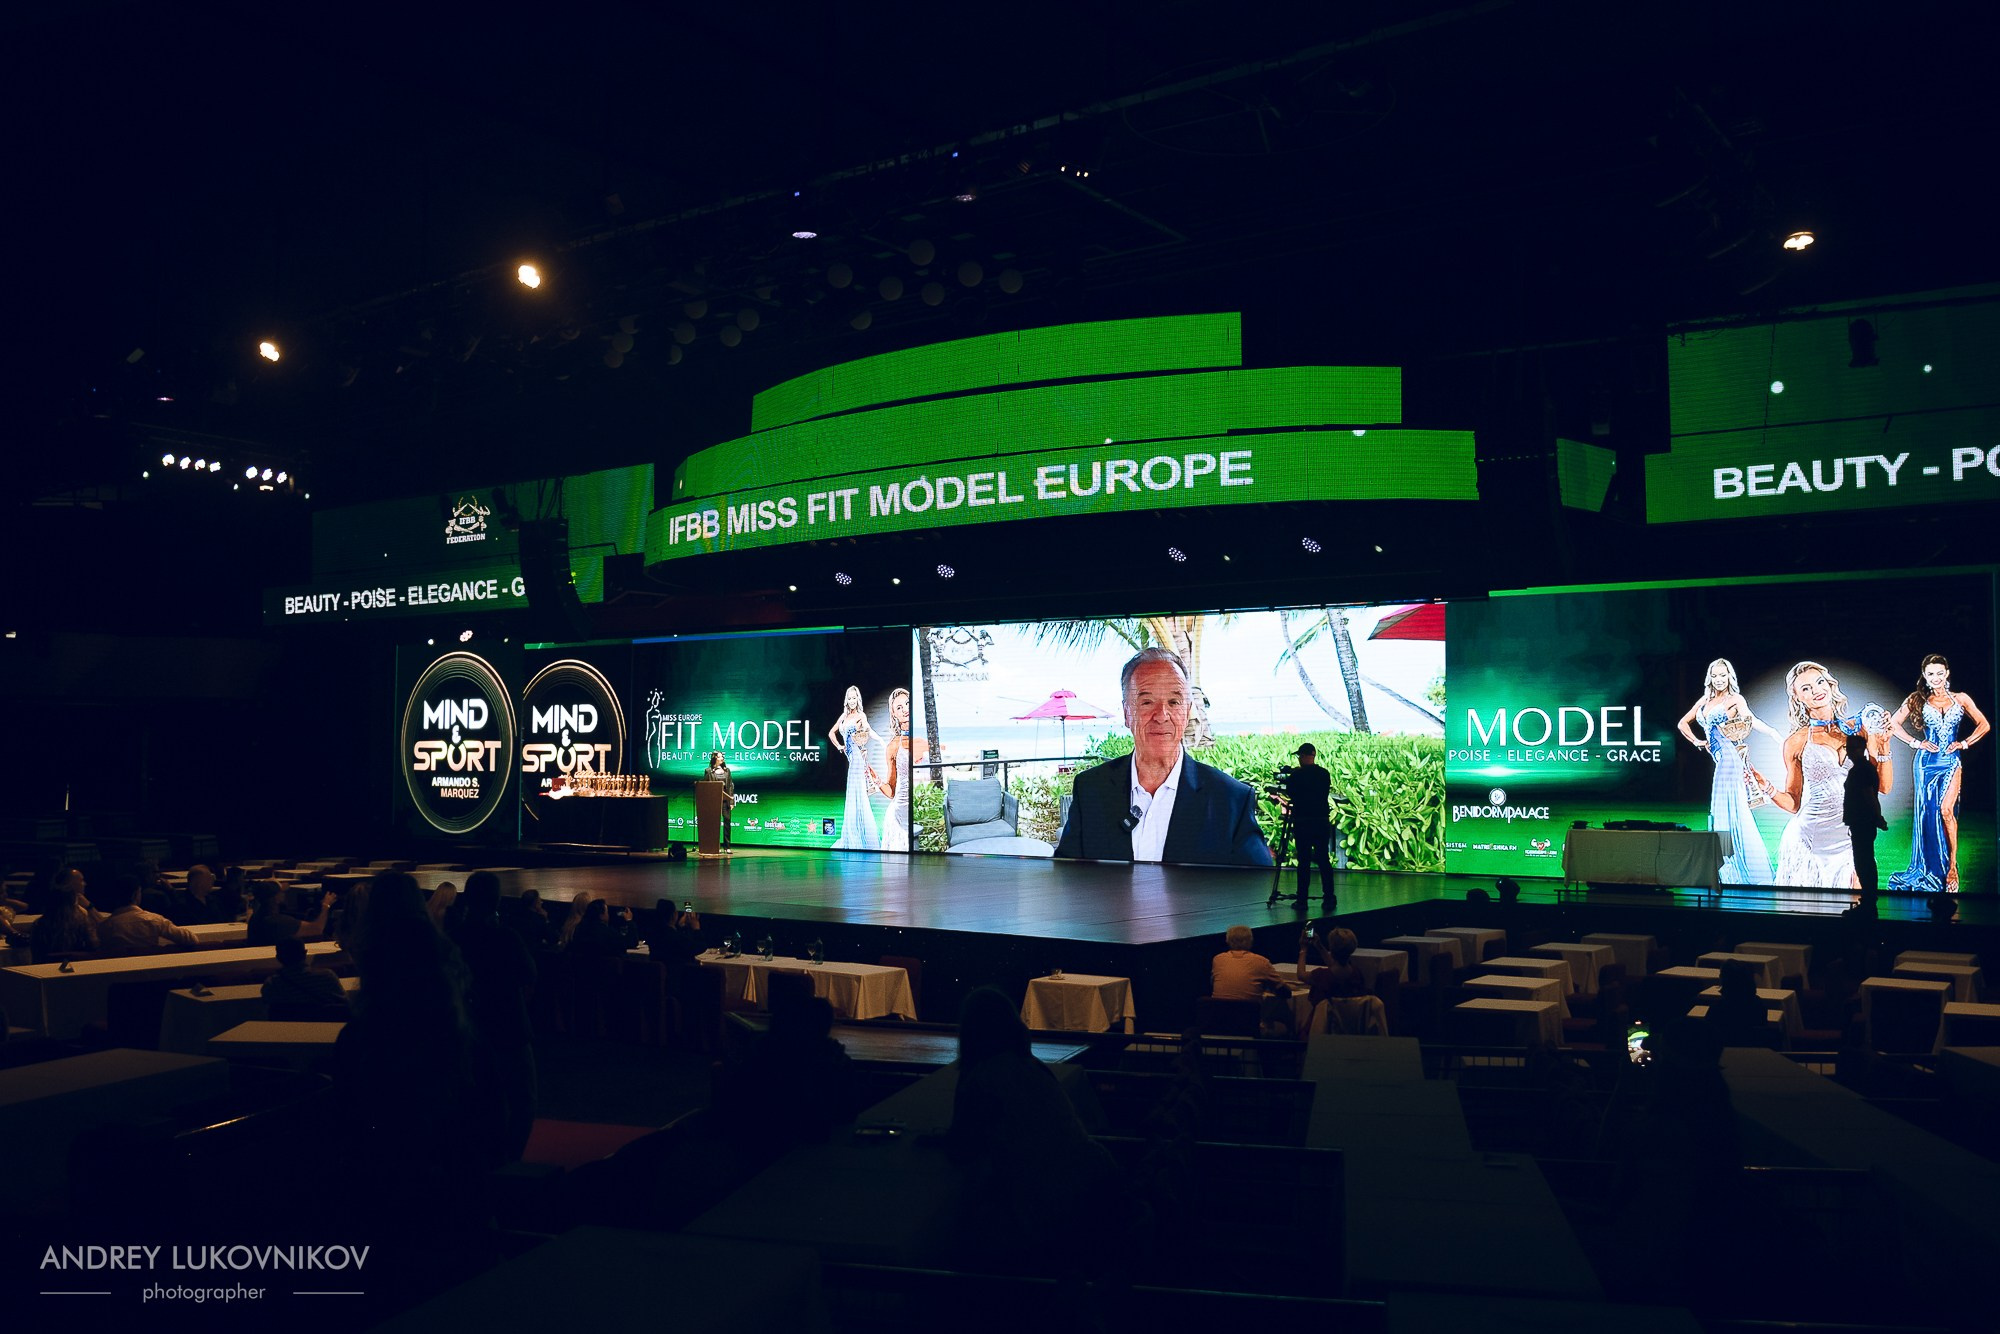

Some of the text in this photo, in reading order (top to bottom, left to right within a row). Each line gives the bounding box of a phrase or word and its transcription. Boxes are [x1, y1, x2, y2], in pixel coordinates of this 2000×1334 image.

[1713, 452, 1910, 500] BEAUTY
[668, 450, 1254, 545] IFBB MISS FIT MODEL EUROPE
[459, 516, 476, 525] IFBB
[446, 533, 486, 545] FEDERATION
[285, 593, 341, 616] BEAUTY
[351, 588, 397, 610] POISE
[408, 579, 499, 606] ELEGANCE
[423, 698, 489, 730] MIND
[531, 704, 598, 734] MIND
[662, 713, 703, 722] MISS EUROPE
[1467, 706, 1662, 746] MODEL
[661, 720, 820, 750] FIT MODEL
[413, 740, 502, 772] SPORT
[522, 743, 612, 774] SPORT
[661, 751, 694, 761] BEAUTY
[734, 751, 780, 762] ELEGANCE
[789, 751, 820, 762] GRACE
[1448, 750, 1490, 761] POISE
[1507, 750, 1589, 762] ELEGANCE
[1606, 750, 1661, 762] GRACE
[431, 777, 480, 788] ARMANDO S.
[440, 788, 480, 799] MARQUEZ
